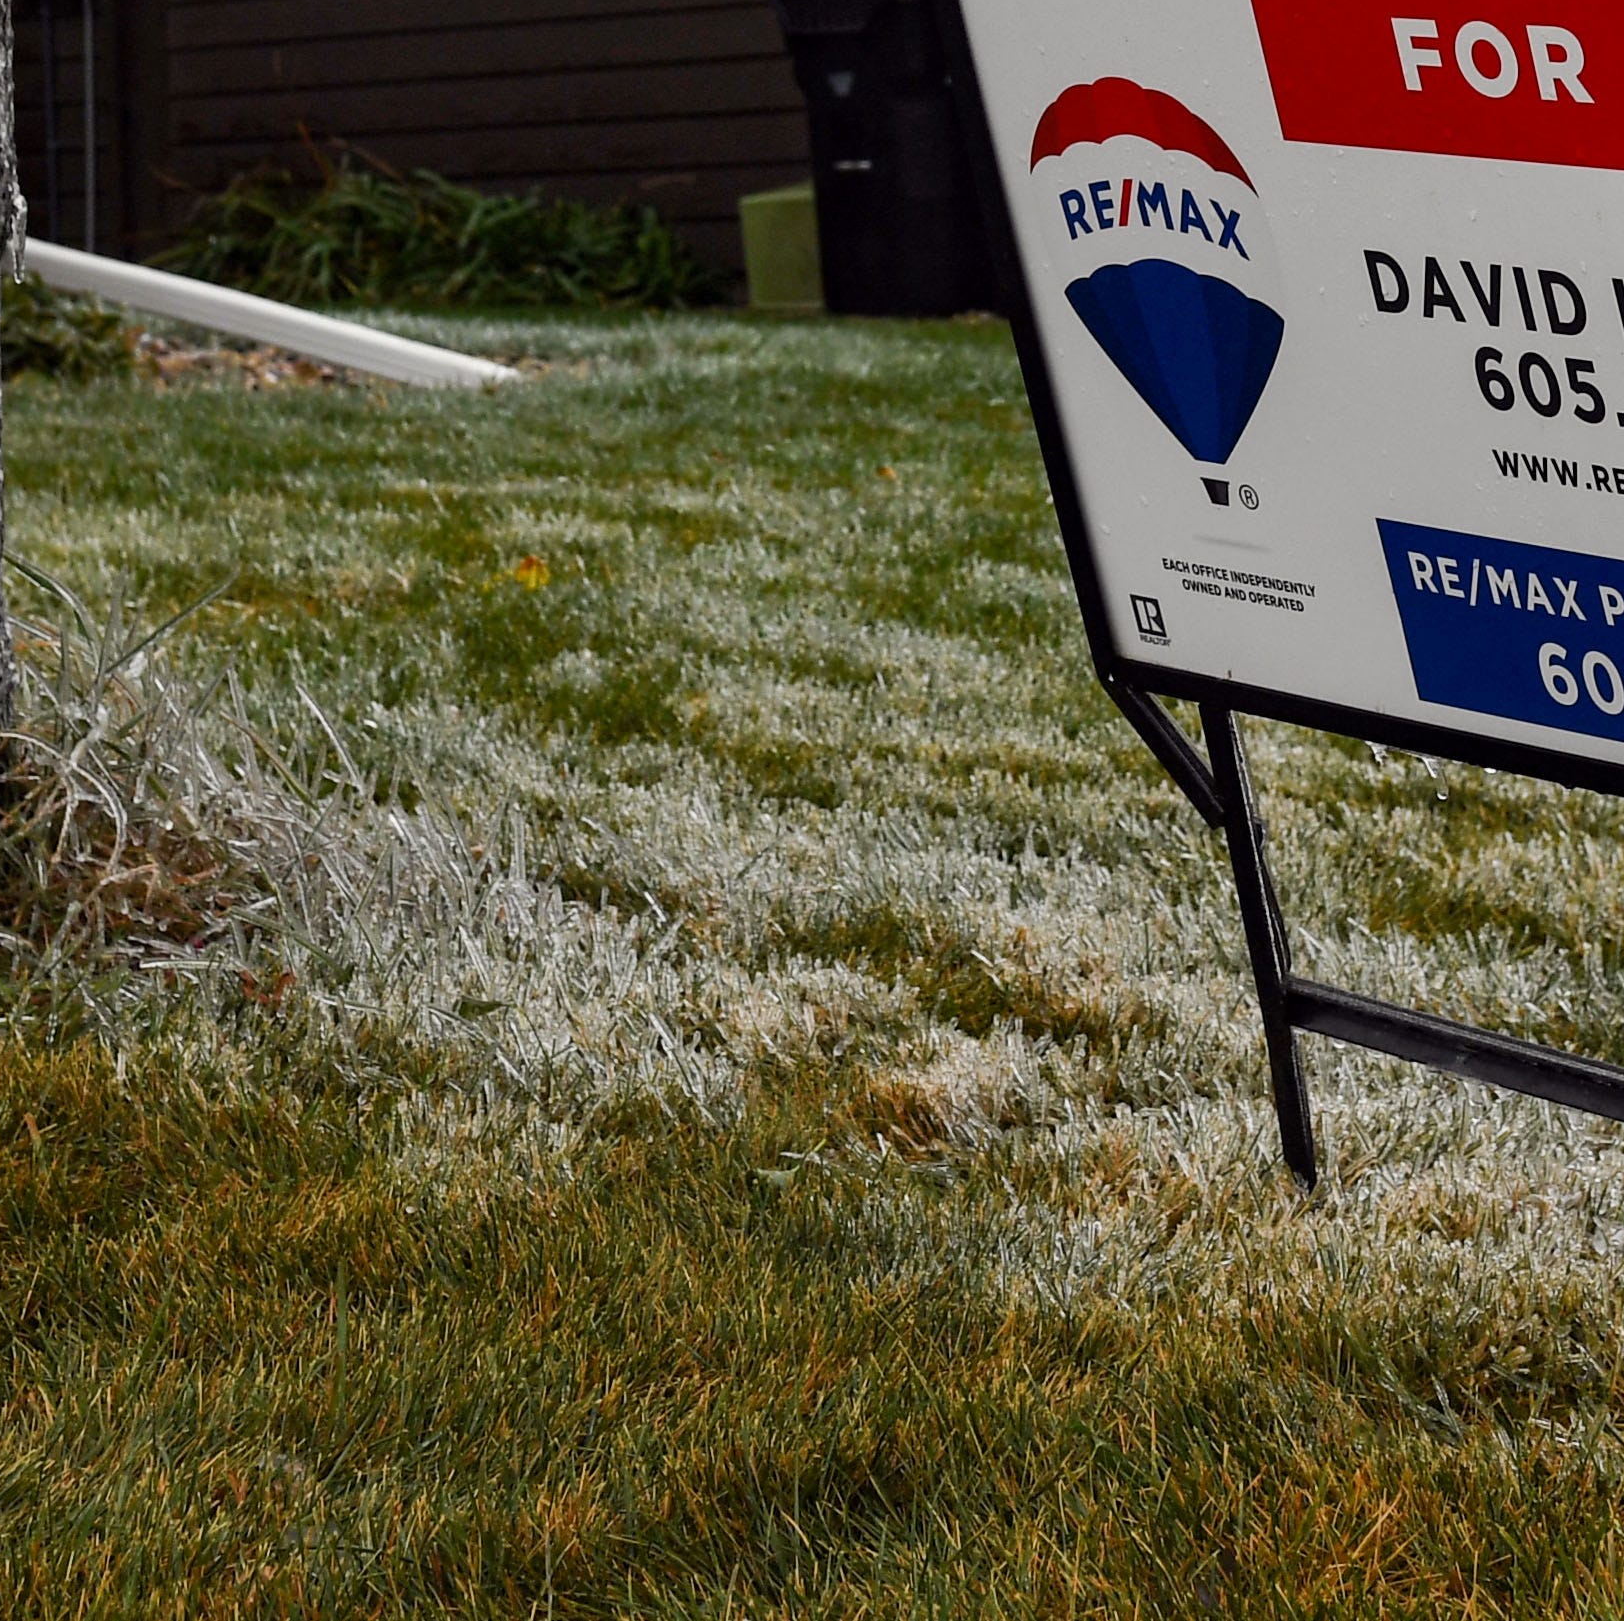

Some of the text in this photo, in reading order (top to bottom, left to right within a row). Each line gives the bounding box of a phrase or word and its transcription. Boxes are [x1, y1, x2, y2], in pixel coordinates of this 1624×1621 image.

[1390, 17, 1596, 104] FOR
[1058, 178, 1251, 262] RE/MAX
[1363, 249, 1587, 336] DAVID
[1161, 557, 1316, 598] EACH OFFICE INDEPENDENTLY
[1181, 578, 1305, 613] OWNED AND OPERATED
[1407, 551, 1587, 621] RE/MAX
